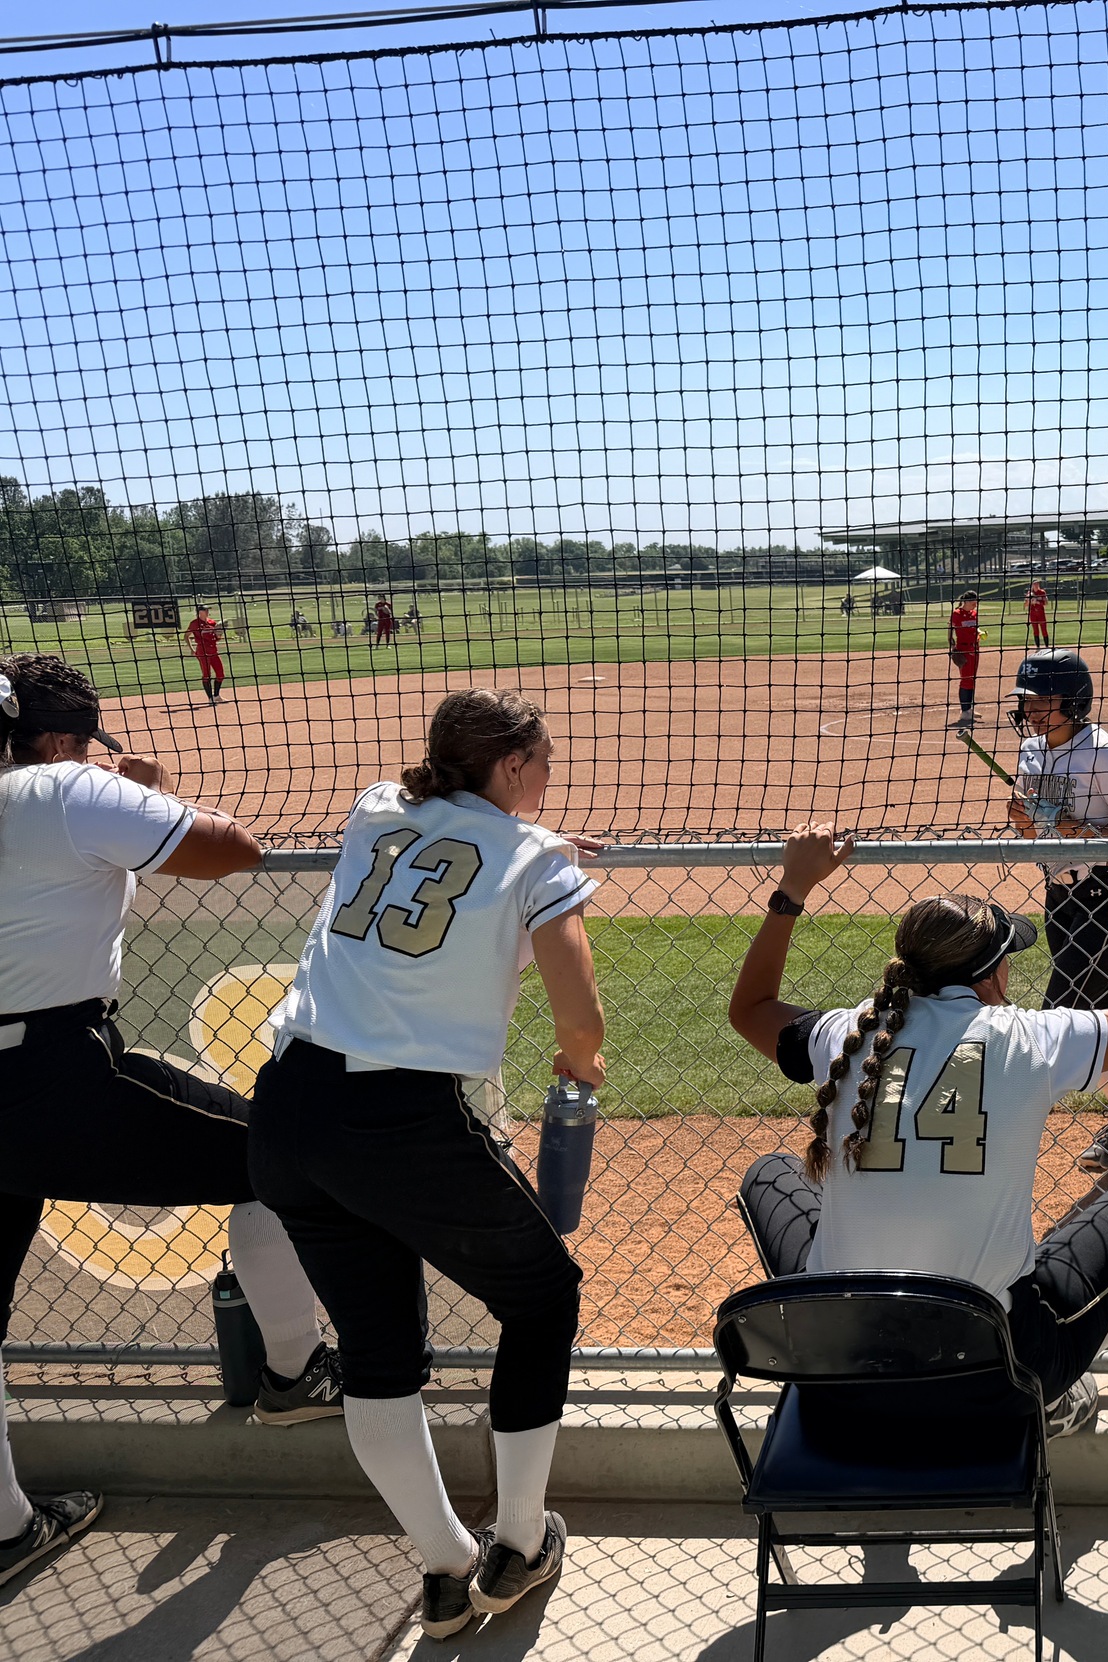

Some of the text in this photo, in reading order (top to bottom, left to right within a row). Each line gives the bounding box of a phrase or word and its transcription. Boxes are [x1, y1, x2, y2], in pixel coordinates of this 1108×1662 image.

[133, 604, 176, 624] 203
[330, 828, 483, 958] 13
[856, 1041, 988, 1175] 14
